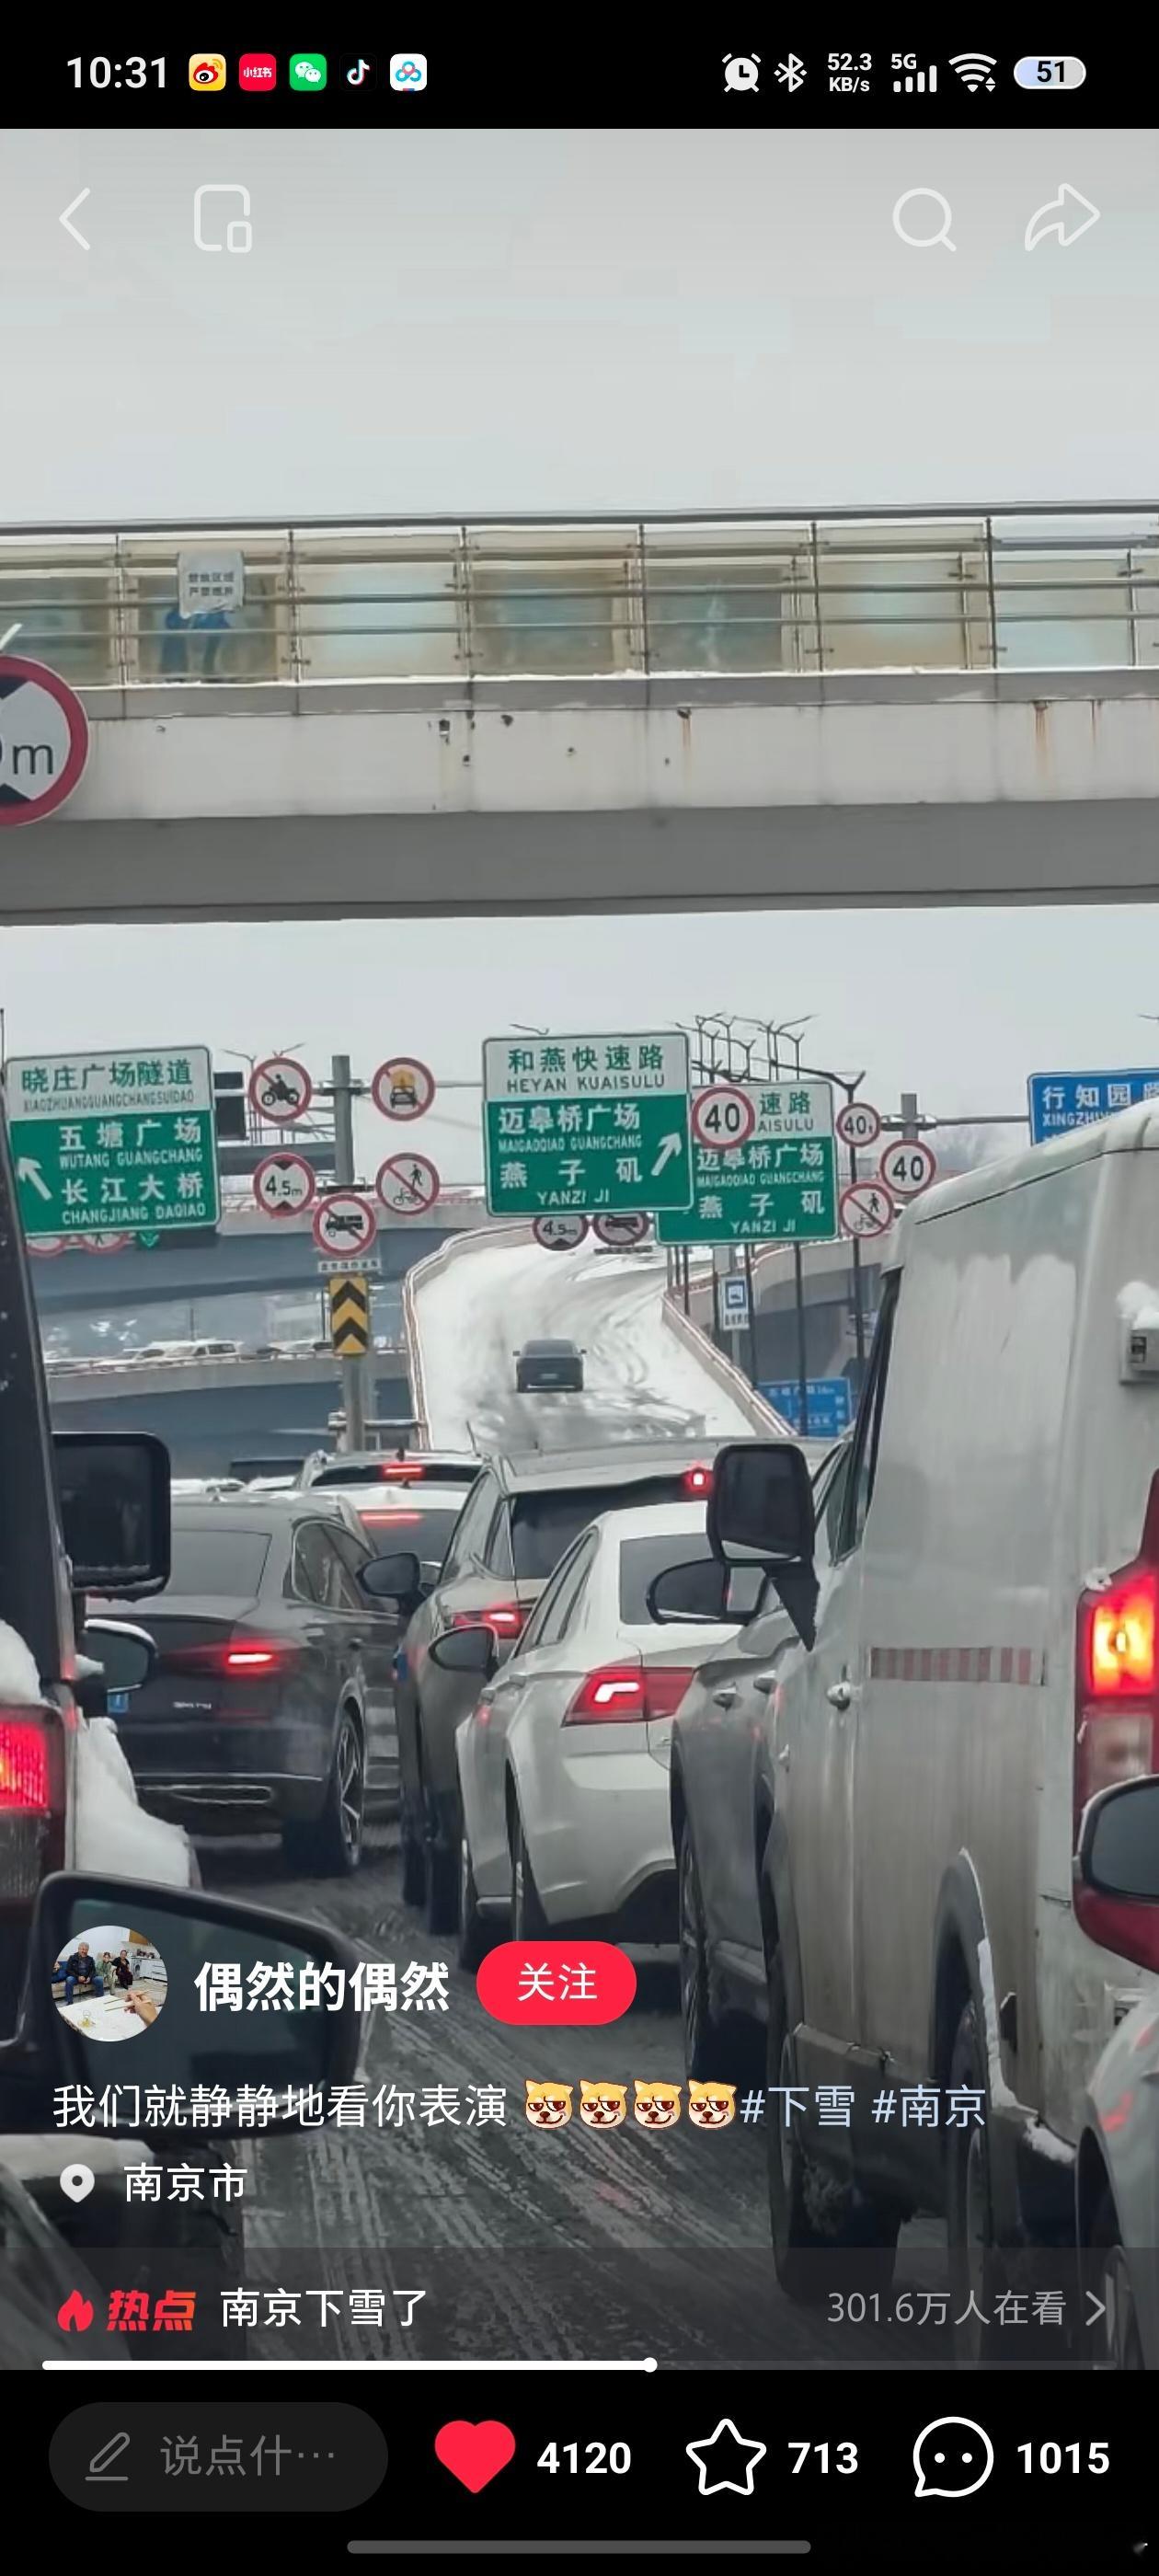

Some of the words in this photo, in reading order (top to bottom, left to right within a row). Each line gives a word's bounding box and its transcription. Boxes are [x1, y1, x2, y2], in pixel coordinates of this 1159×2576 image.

[0, 739, 52, 775] m
[508, 1043, 664, 1075] 和燕快速路
[21, 1058, 193, 1094] 晓庄广场隧道
[507, 1076, 568, 1093] HEYAN
[578, 1074, 664, 1091] KUAISULU
[759, 1089, 811, 1115] 速路
[498, 1102, 641, 1135] 迈皋桥广场
[705, 1102, 740, 1133] 40
[59, 1116, 201, 1152] 五塘广场
[498, 1137, 565, 1154] MAIGAOQIAO
[569, 1133, 643, 1151] GUANGCHANG
[59, 1153, 110, 1170] WUTANG
[117, 1148, 203, 1167] GUANGCHANG
[891, 1155, 924, 1182] 40
[265, 1175, 304, 1197] 4.5m
[499, 1156, 643, 1190] 燕子矶
[760, 1169, 825, 1186] GUANGCHANG
[61, 1171, 204, 1205] 长江大桥
[536, 1190, 586, 1206] YANZI
[593, 1189, 610, 1203] JI
[62, 1205, 149, 1225] CHANGJIANG
[155, 1202, 207, 1219] DAQIAO
[698, 1190, 826, 1219] 燕子矶
[542, 1220, 578, 1236] 4.5m
[729, 1220, 777, 1235] YANZI
[783, 1219, 797, 1233] JI
